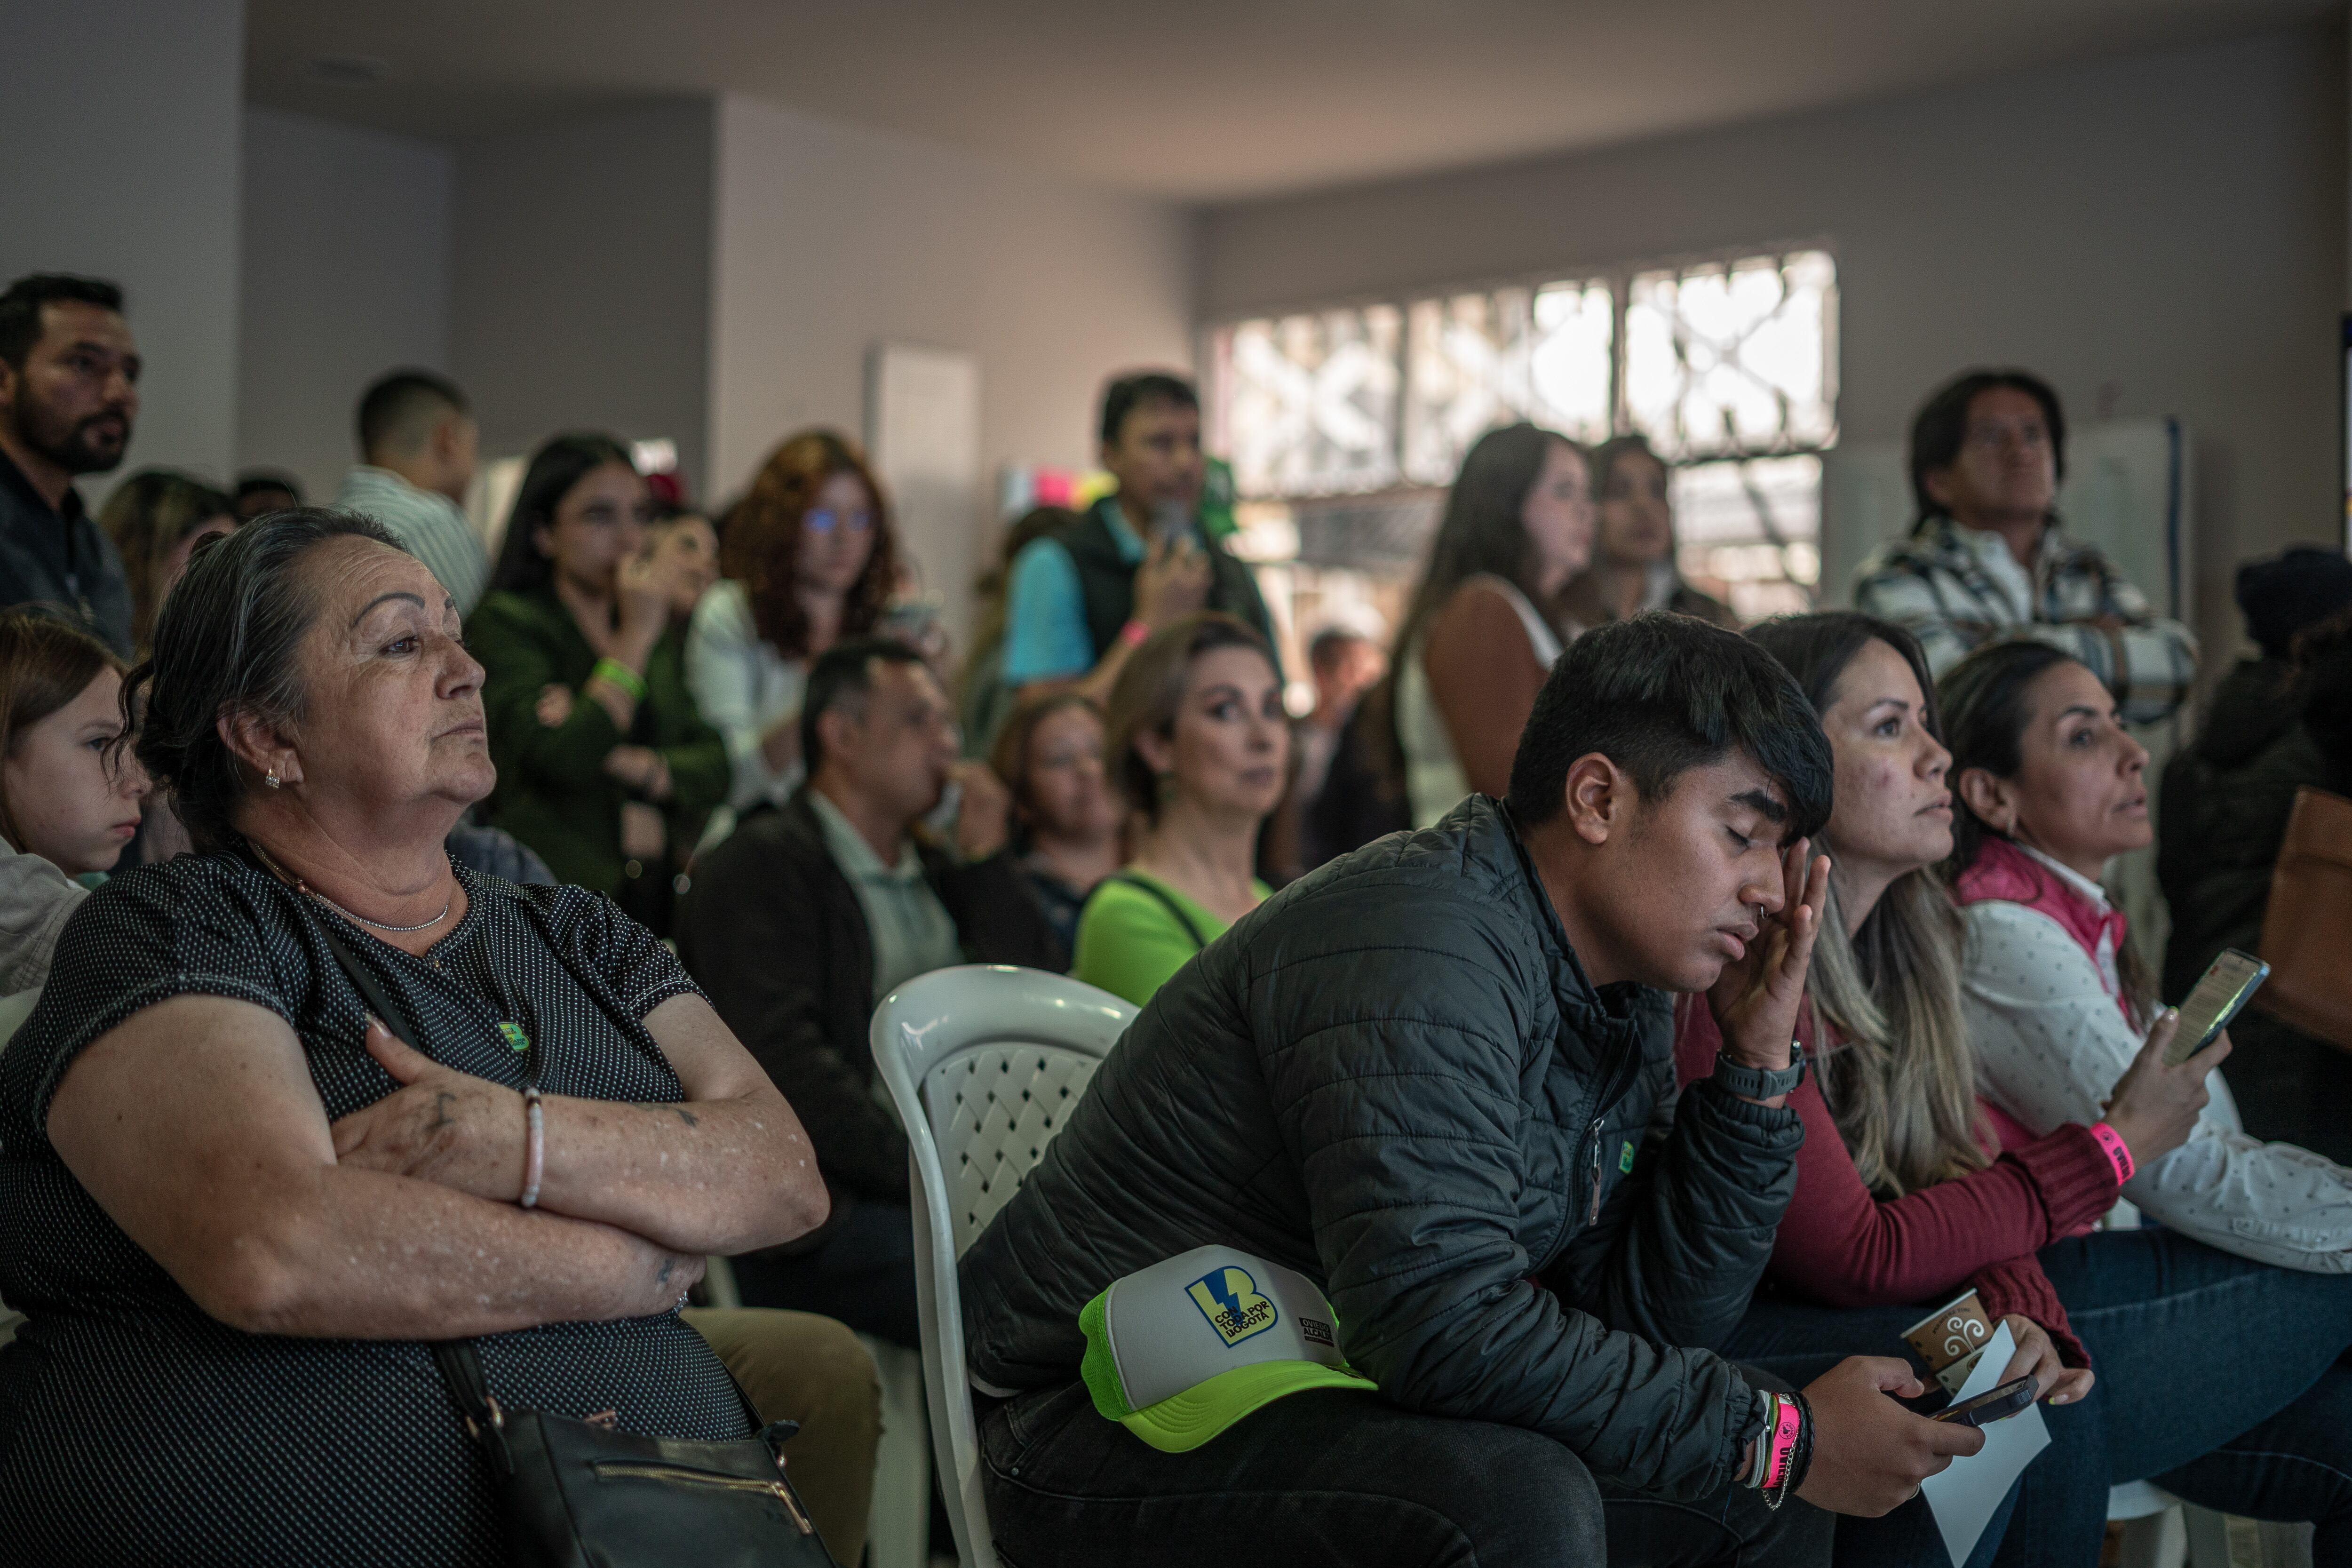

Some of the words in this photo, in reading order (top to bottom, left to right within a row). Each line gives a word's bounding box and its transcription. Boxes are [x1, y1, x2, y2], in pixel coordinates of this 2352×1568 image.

[1215, 1306, 1238, 1323] CON
[1219, 1311, 1250, 1330] TODA
[1247, 1301, 1270, 1315] POR
[1302, 1319, 1329, 1332] OVIEDO
